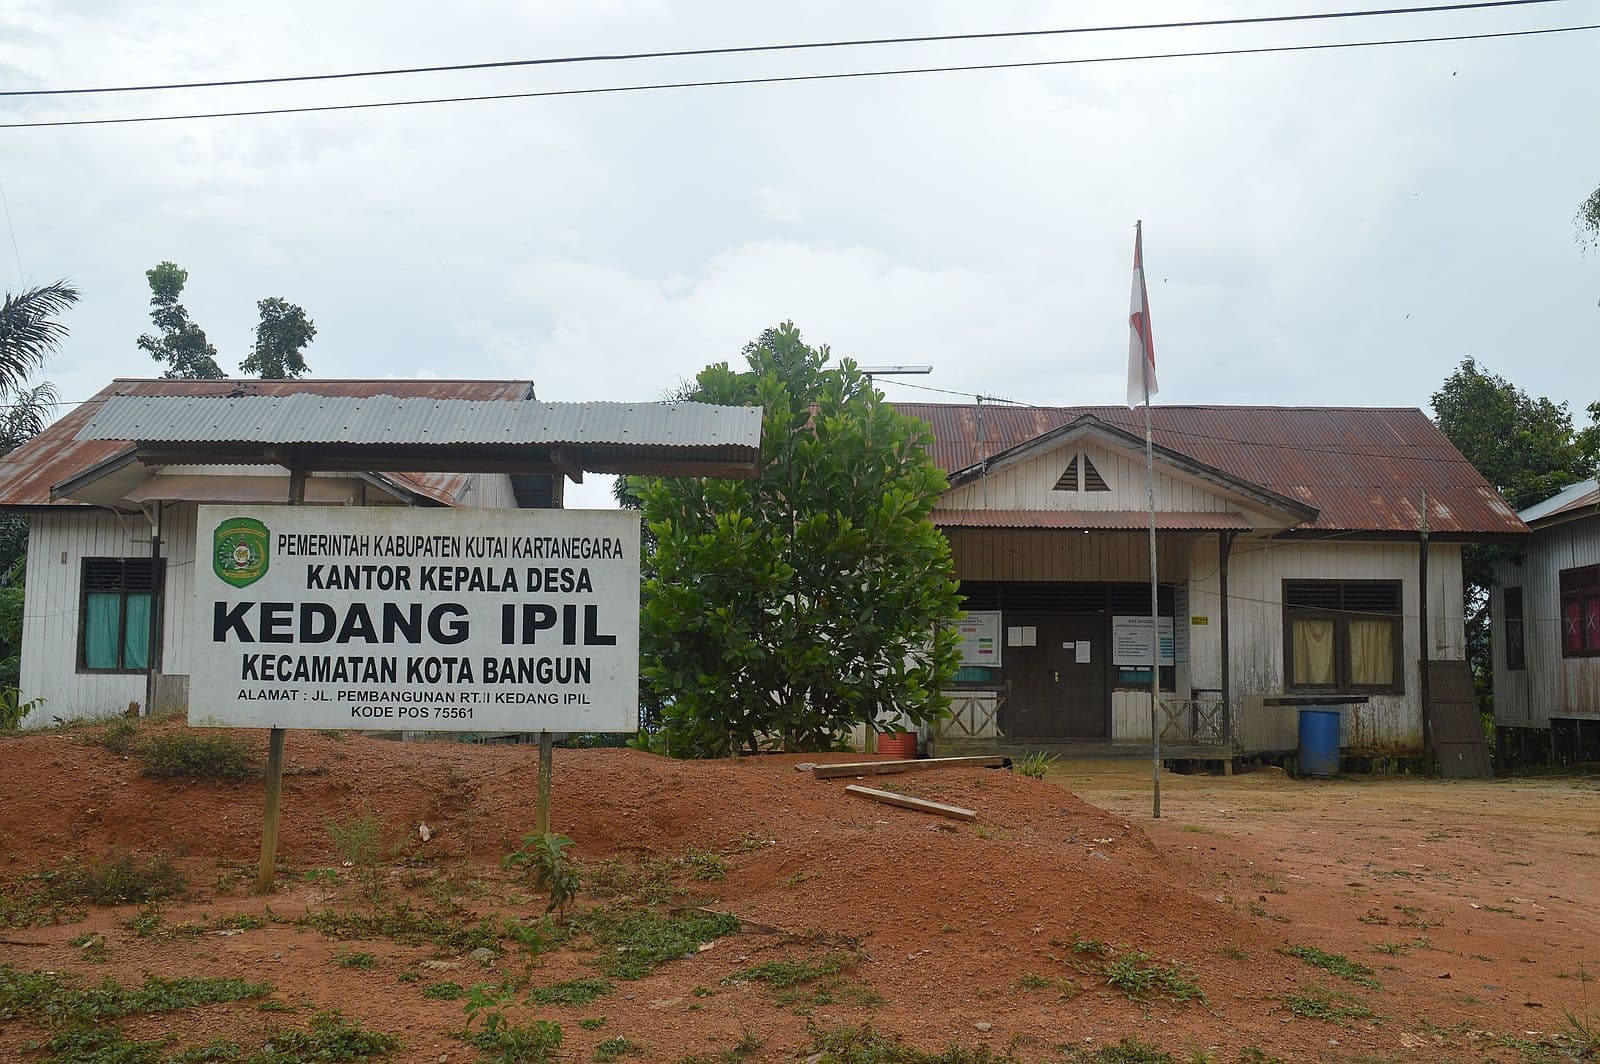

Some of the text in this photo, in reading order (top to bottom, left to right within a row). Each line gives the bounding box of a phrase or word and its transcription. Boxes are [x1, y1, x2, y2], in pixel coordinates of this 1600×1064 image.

[277, 533, 624, 560] PEMERINTAH KABUPATEN KUTAI KARTANEGARA
[306, 564, 594, 594] KANTOR KEPALA DESA
[212, 601, 617, 646] KEDANG IPIL
[241, 653, 591, 685] KECAMATAN KOTA BANGUN
[237, 689, 300, 701] ALAMAT
[311, 689, 334, 702] JL.
[337, 690, 455, 704] PEMBANGUNAN
[495, 692, 559, 705] KEDANG
[563, 693, 591, 705] IPIL
[351, 706, 473, 719] KODE POS 75561
